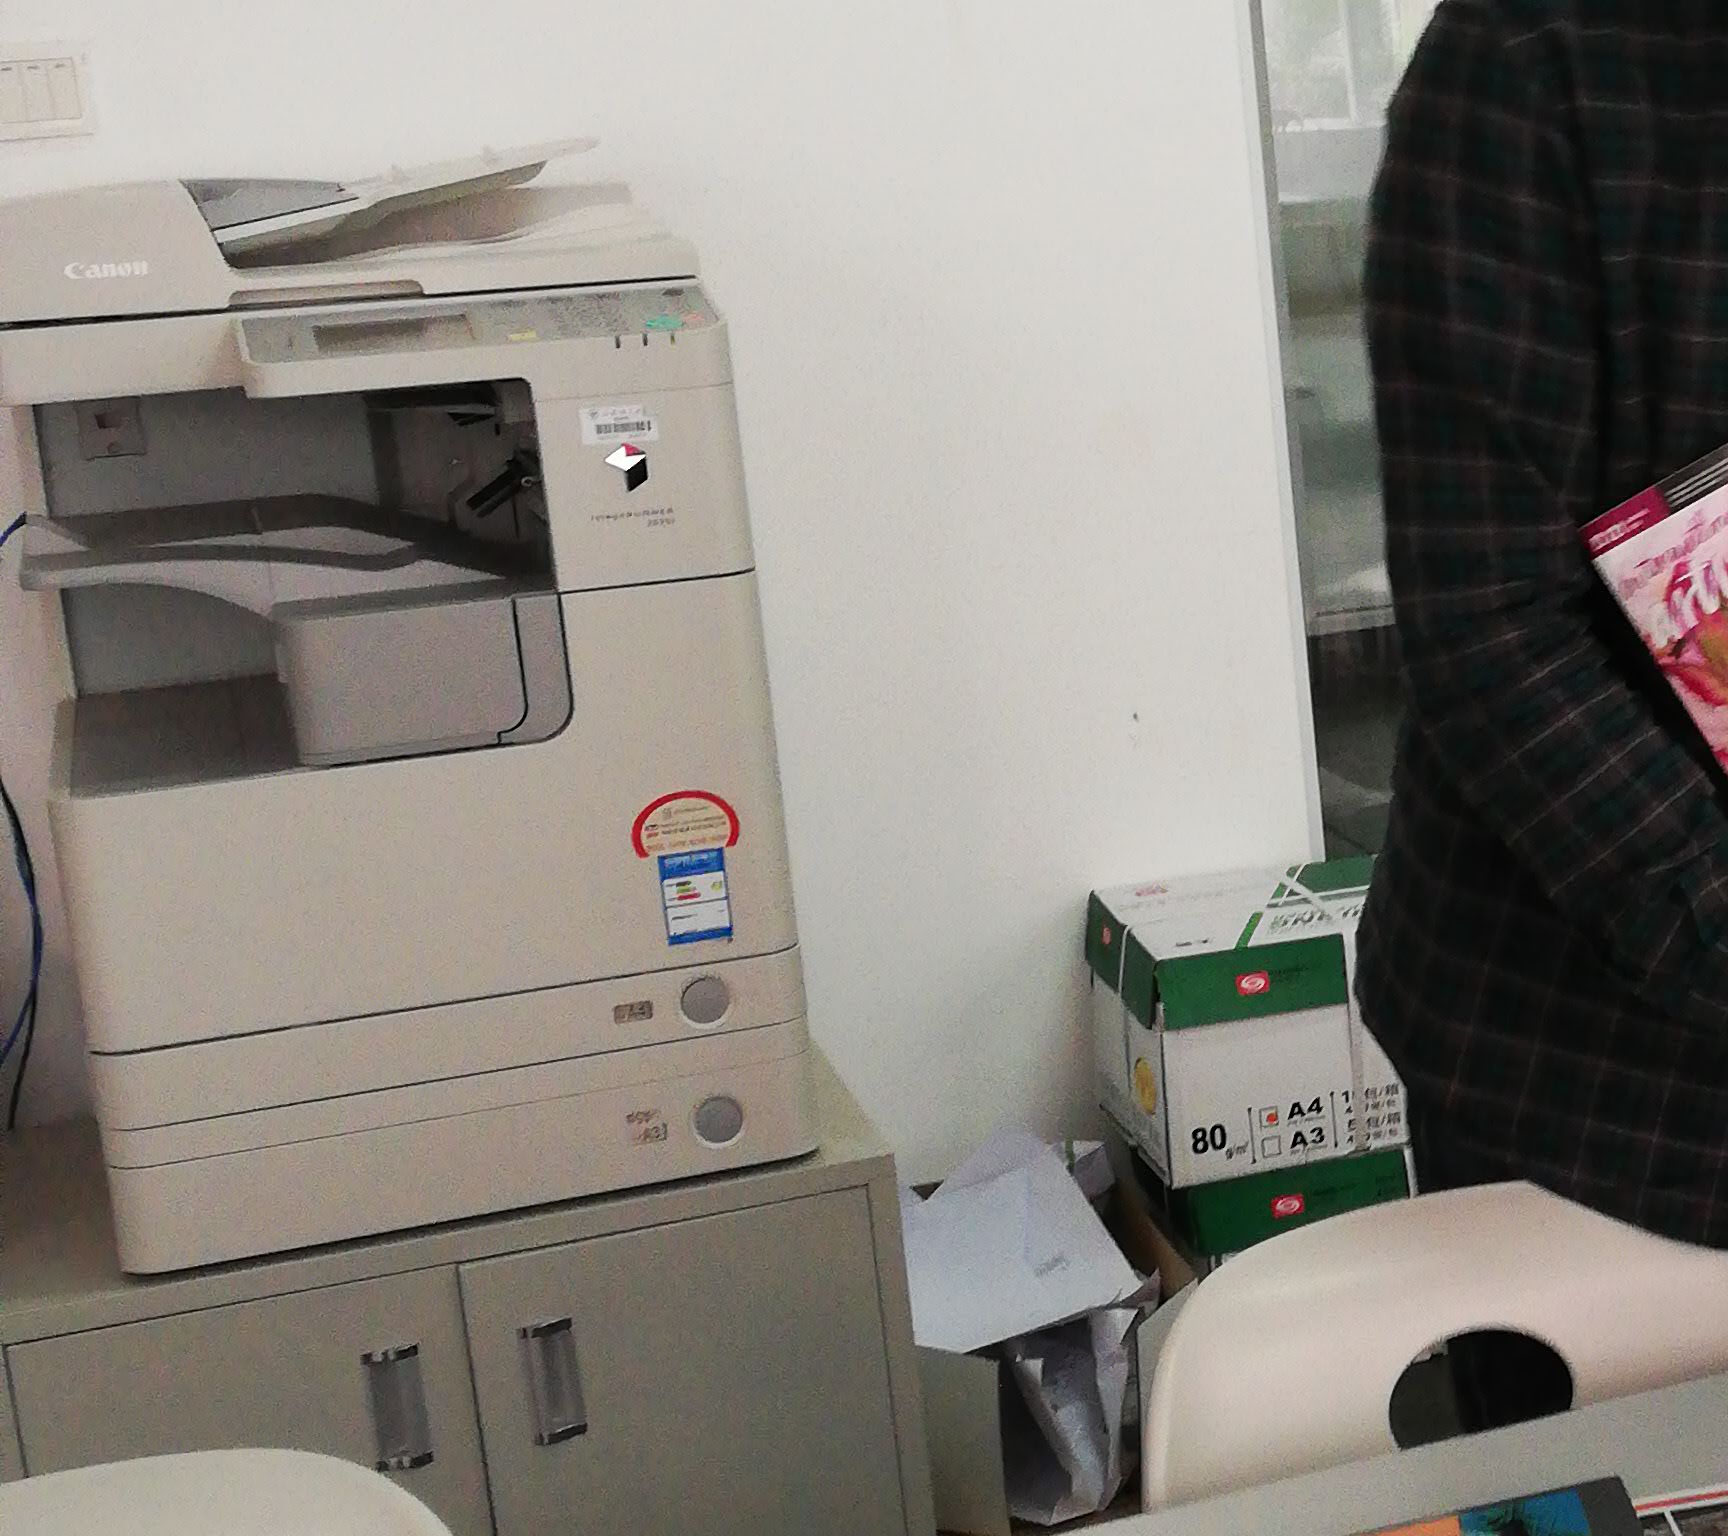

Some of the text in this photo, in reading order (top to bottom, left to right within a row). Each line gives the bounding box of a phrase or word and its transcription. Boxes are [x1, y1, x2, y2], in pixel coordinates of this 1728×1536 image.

[64, 261, 148, 280] Canon
[1287, 1096, 1323, 1120] A4
[1191, 1123, 1227, 1155] 80
[1290, 1126, 1326, 1150] A3
